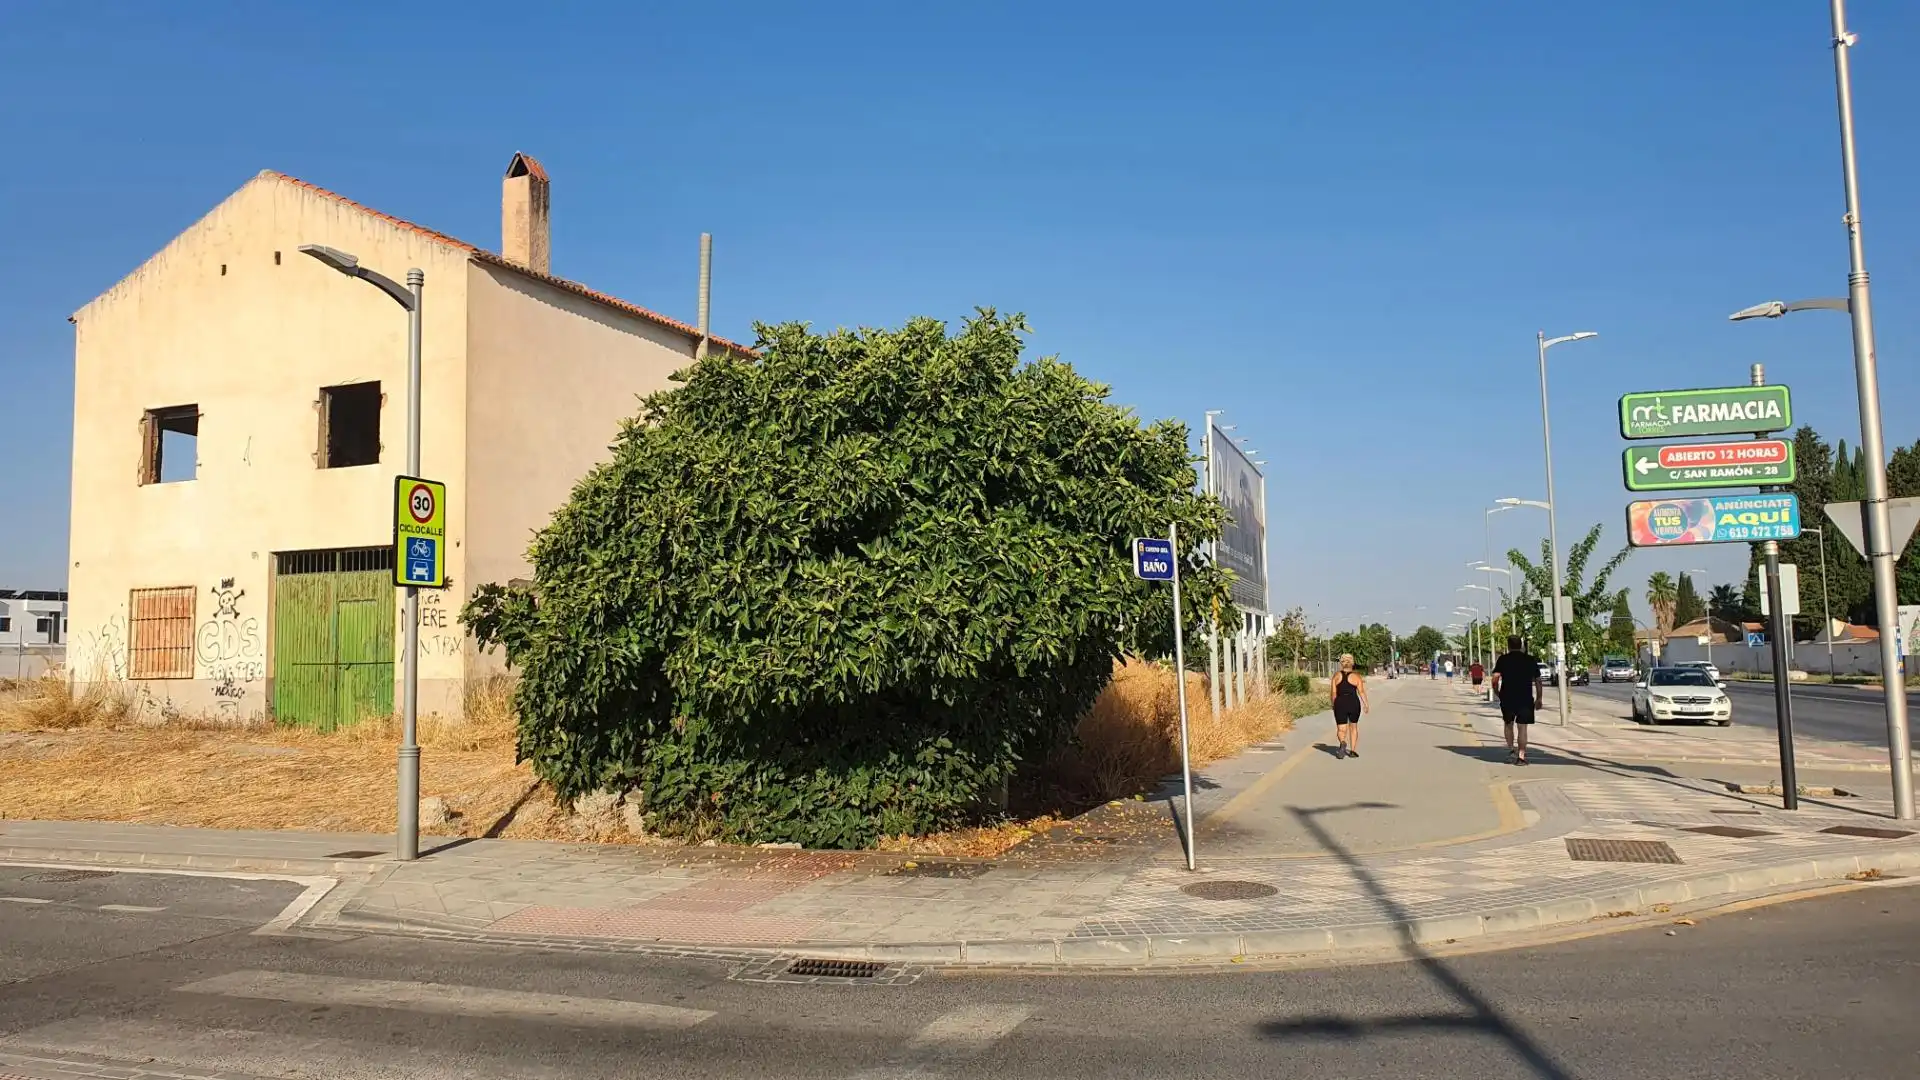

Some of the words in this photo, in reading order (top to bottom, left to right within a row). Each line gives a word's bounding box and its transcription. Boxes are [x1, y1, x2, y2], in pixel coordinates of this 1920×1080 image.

[1672, 399, 1782, 424] FARMACIA
[1631, 420, 1672, 429] FARMACIA
[1667, 450, 1716, 463] ABIERTO
[1720, 449, 1734, 460] 12
[1737, 447, 1779, 459] HORAS
[1669, 470, 1681, 480] C/
[1683, 468, 1707, 479] SAN
[1710, 464, 1753, 478] RAMÓN
[1764, 466, 1779, 476] 28
[413, 496, 430, 511] 30
[1655, 516, 1681, 527] TUS
[1718, 508, 1790, 526] AQUÍ
[399, 523, 443, 537] CICLOCALLE
[1729, 527, 1749, 538] 619
[1751, 525, 1771, 538] 472
[1142, 558, 1168, 573] BAÑO
[400, 634, 462, 664] NTRAX
